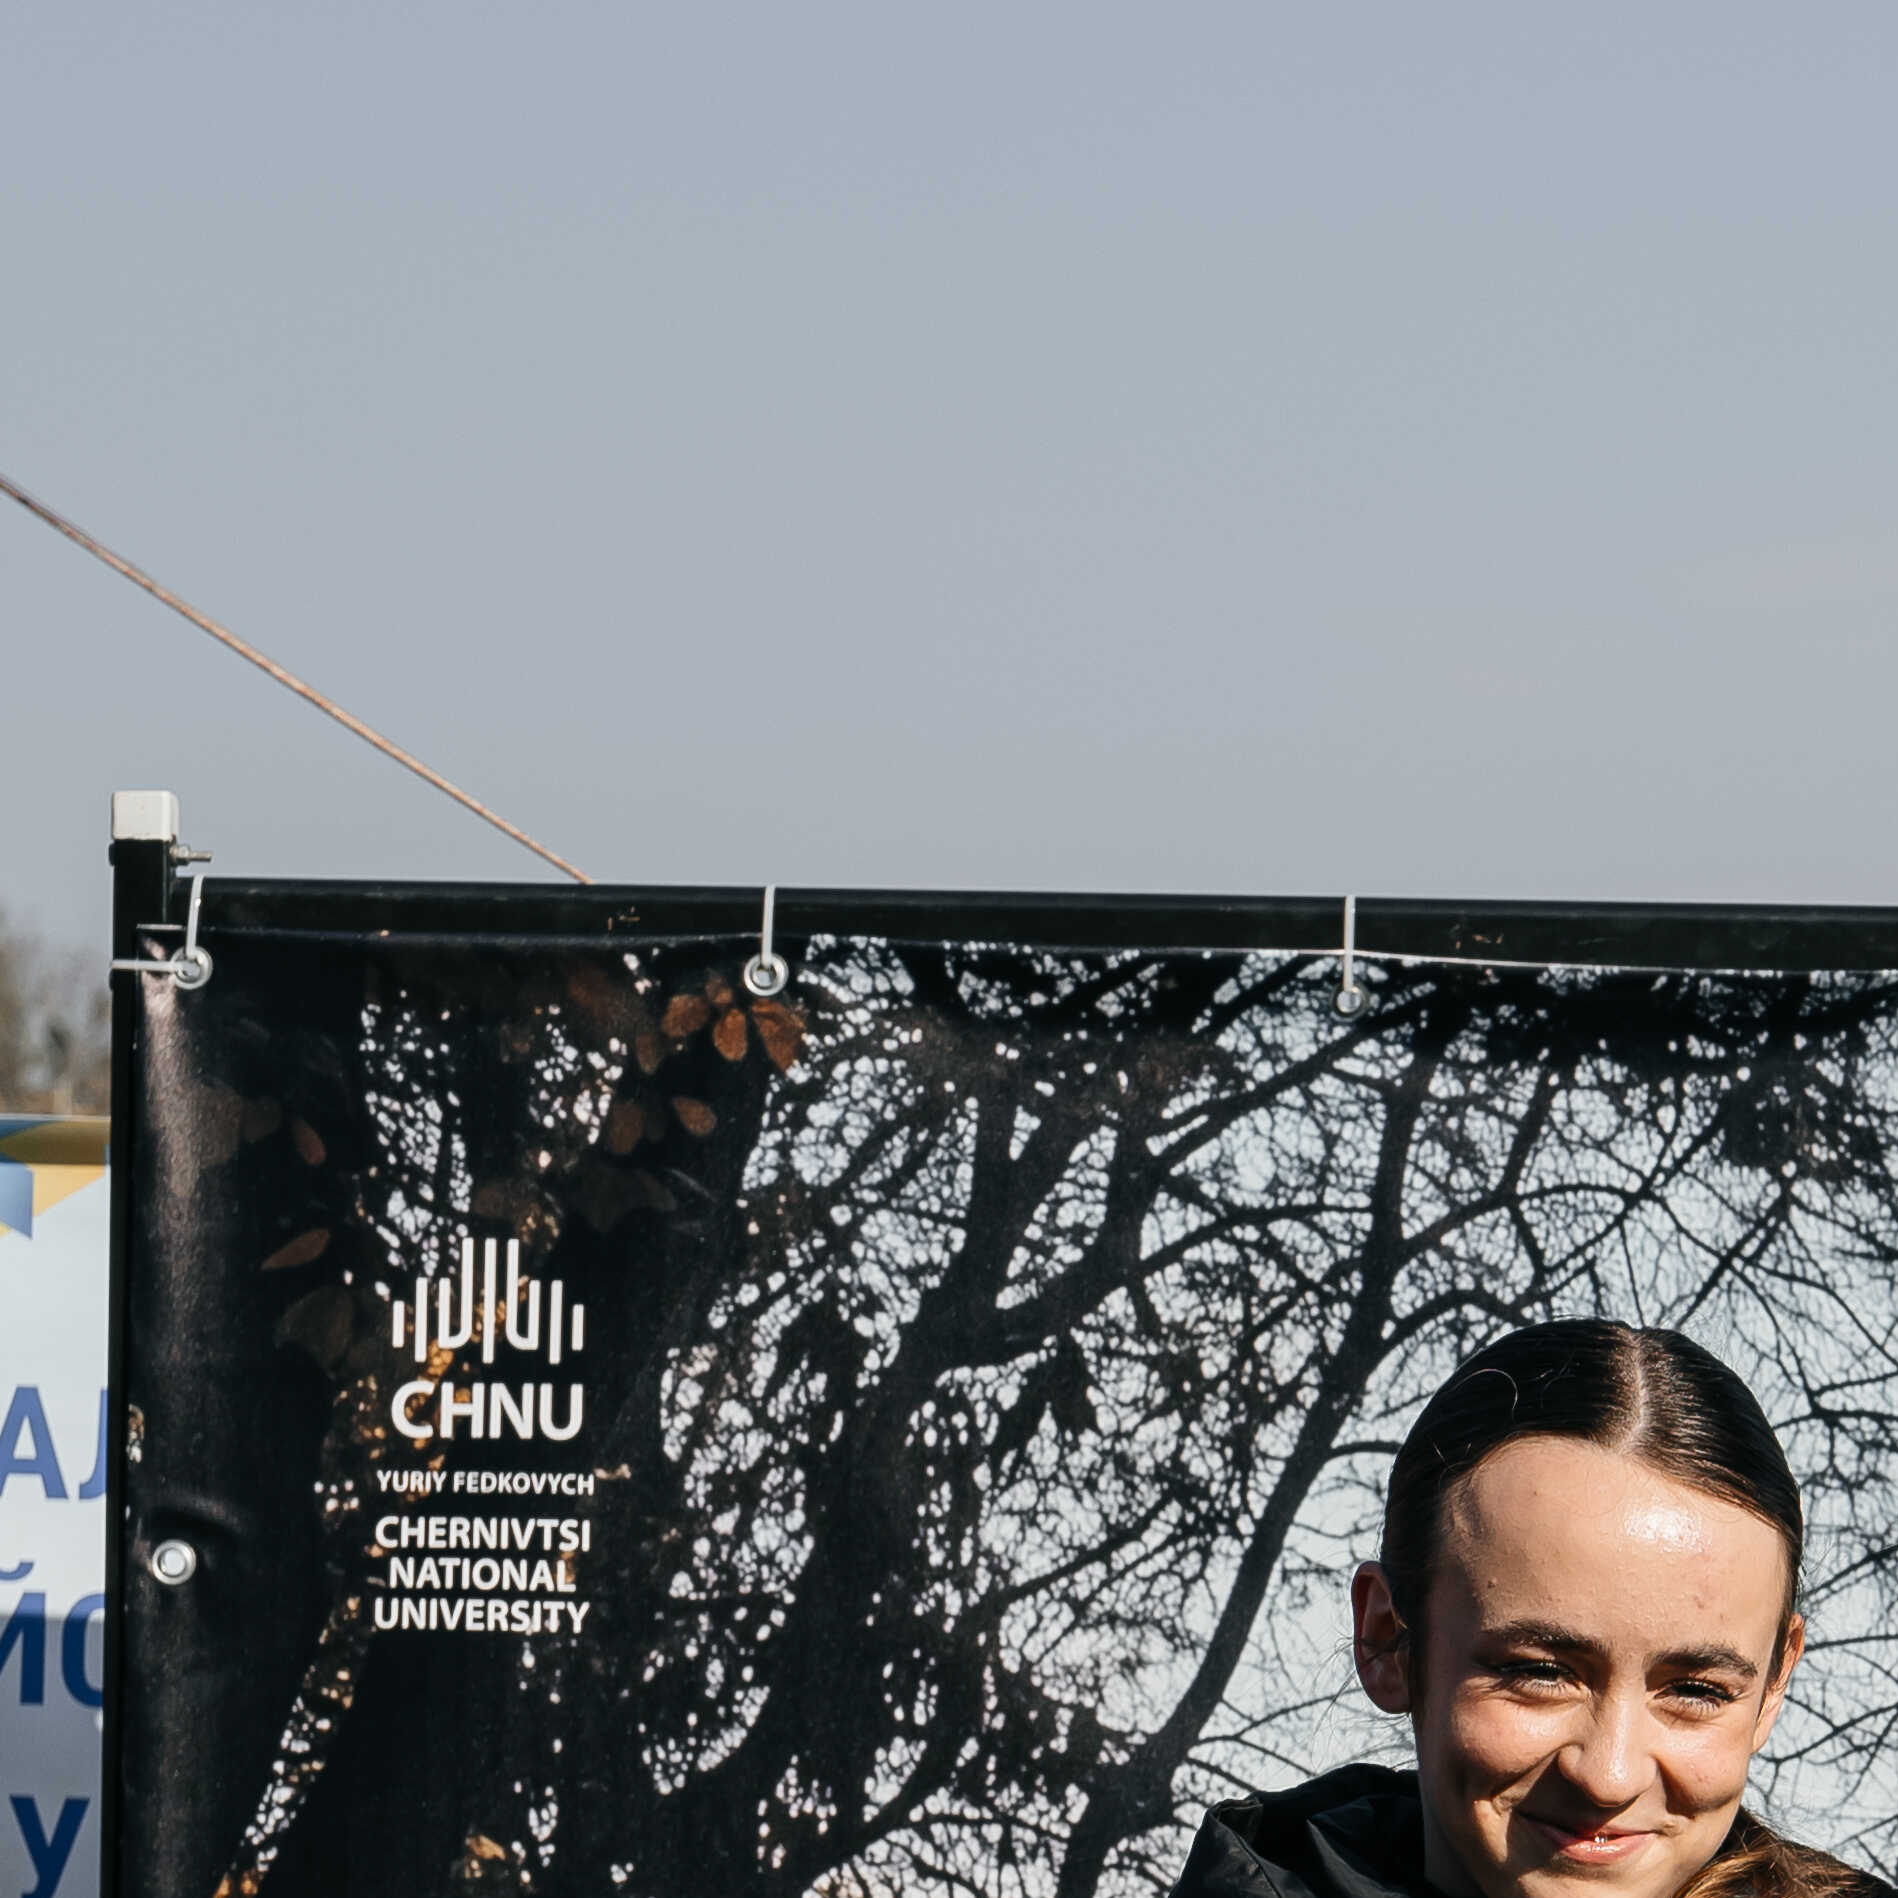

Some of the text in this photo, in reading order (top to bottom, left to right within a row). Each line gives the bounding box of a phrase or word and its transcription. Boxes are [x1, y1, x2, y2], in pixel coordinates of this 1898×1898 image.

[391, 1381, 584, 1441] CHNU
[377, 1470, 595, 1496] YURIY FEDKOVYCH
[375, 1515, 591, 1552] CHERNIVTSI
[389, 1556, 576, 1592] NATIONAL
[374, 1597, 590, 1634] UNIVERSITY
